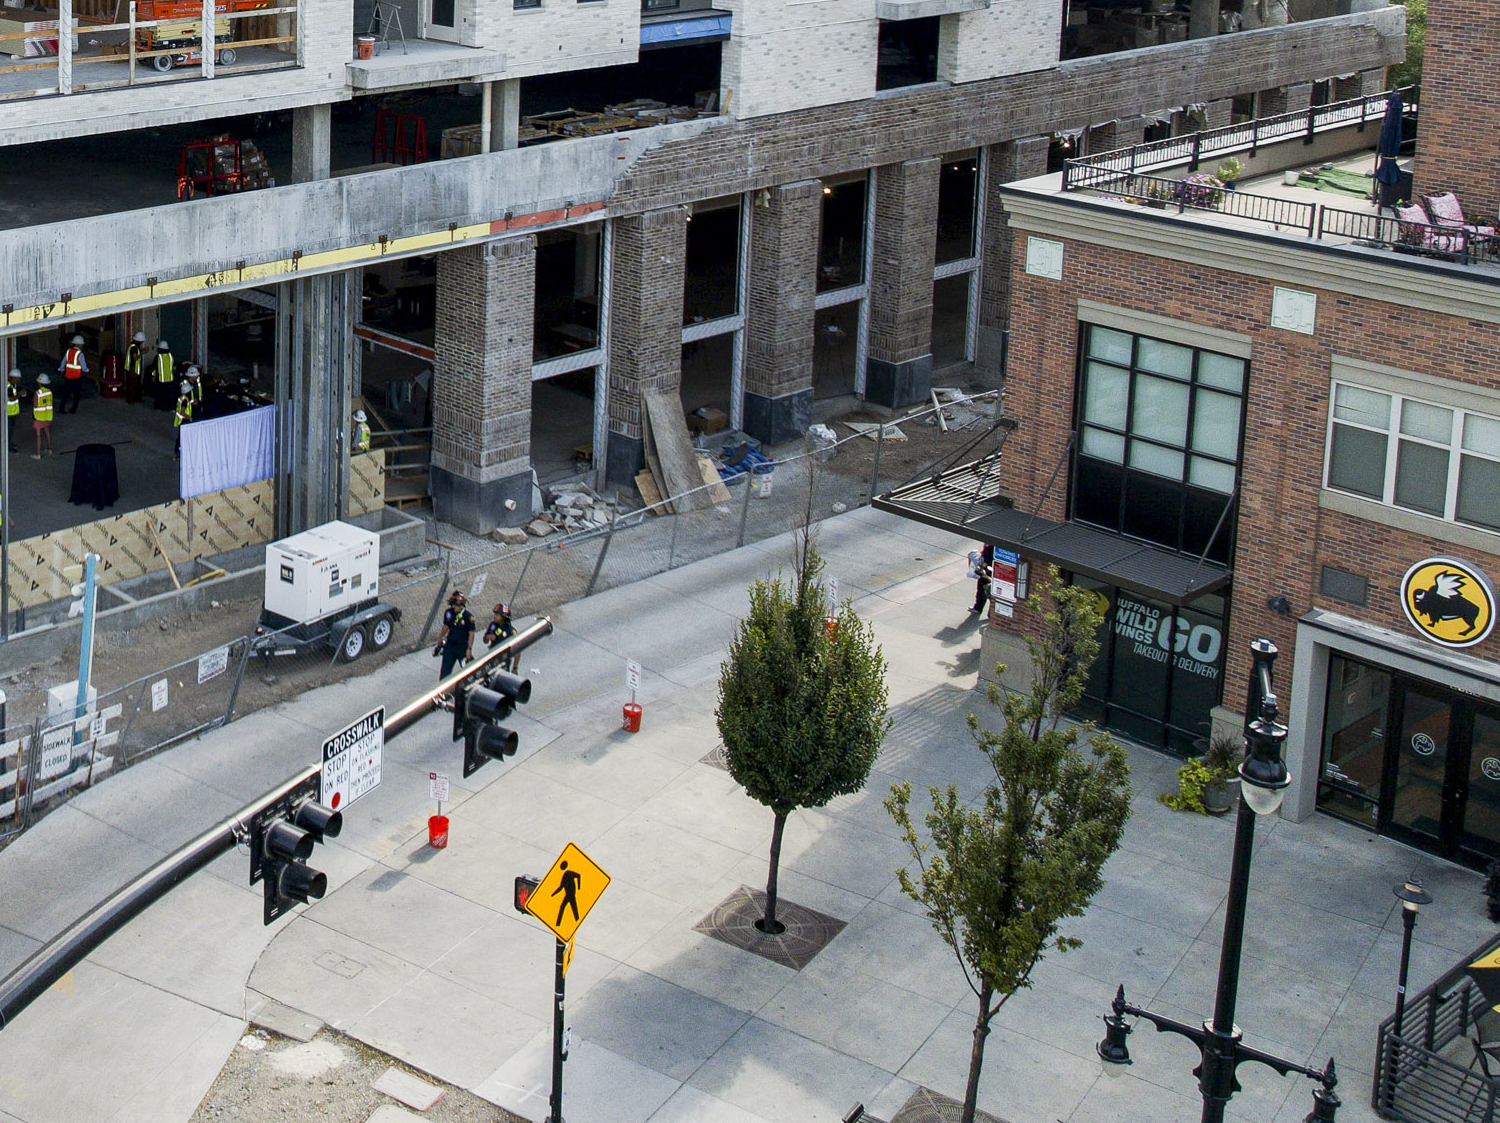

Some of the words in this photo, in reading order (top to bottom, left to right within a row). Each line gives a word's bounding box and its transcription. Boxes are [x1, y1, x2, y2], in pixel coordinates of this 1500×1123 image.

[1157, 615, 1222, 663] GO
[1132, 642, 1169, 664] TAKEOUT
[1177, 656, 1219, 680] DELIVERY
[43, 736, 72, 752] SIDEWALK
[327, 712, 380, 759] CROSSWALK
[357, 733, 375, 753] STOP
[44, 754, 68, 768] CLOSED
[327, 753, 347, 777] STOP
[351, 756, 358, 767] ON
[358, 744, 380, 763] FLASHING
[357, 760, 366, 772] RED
[324, 778, 334, 794] ON
[336, 770, 349, 787] RED
[362, 765, 380, 782] PROCEED
[360, 777, 375, 792] CLEAR
